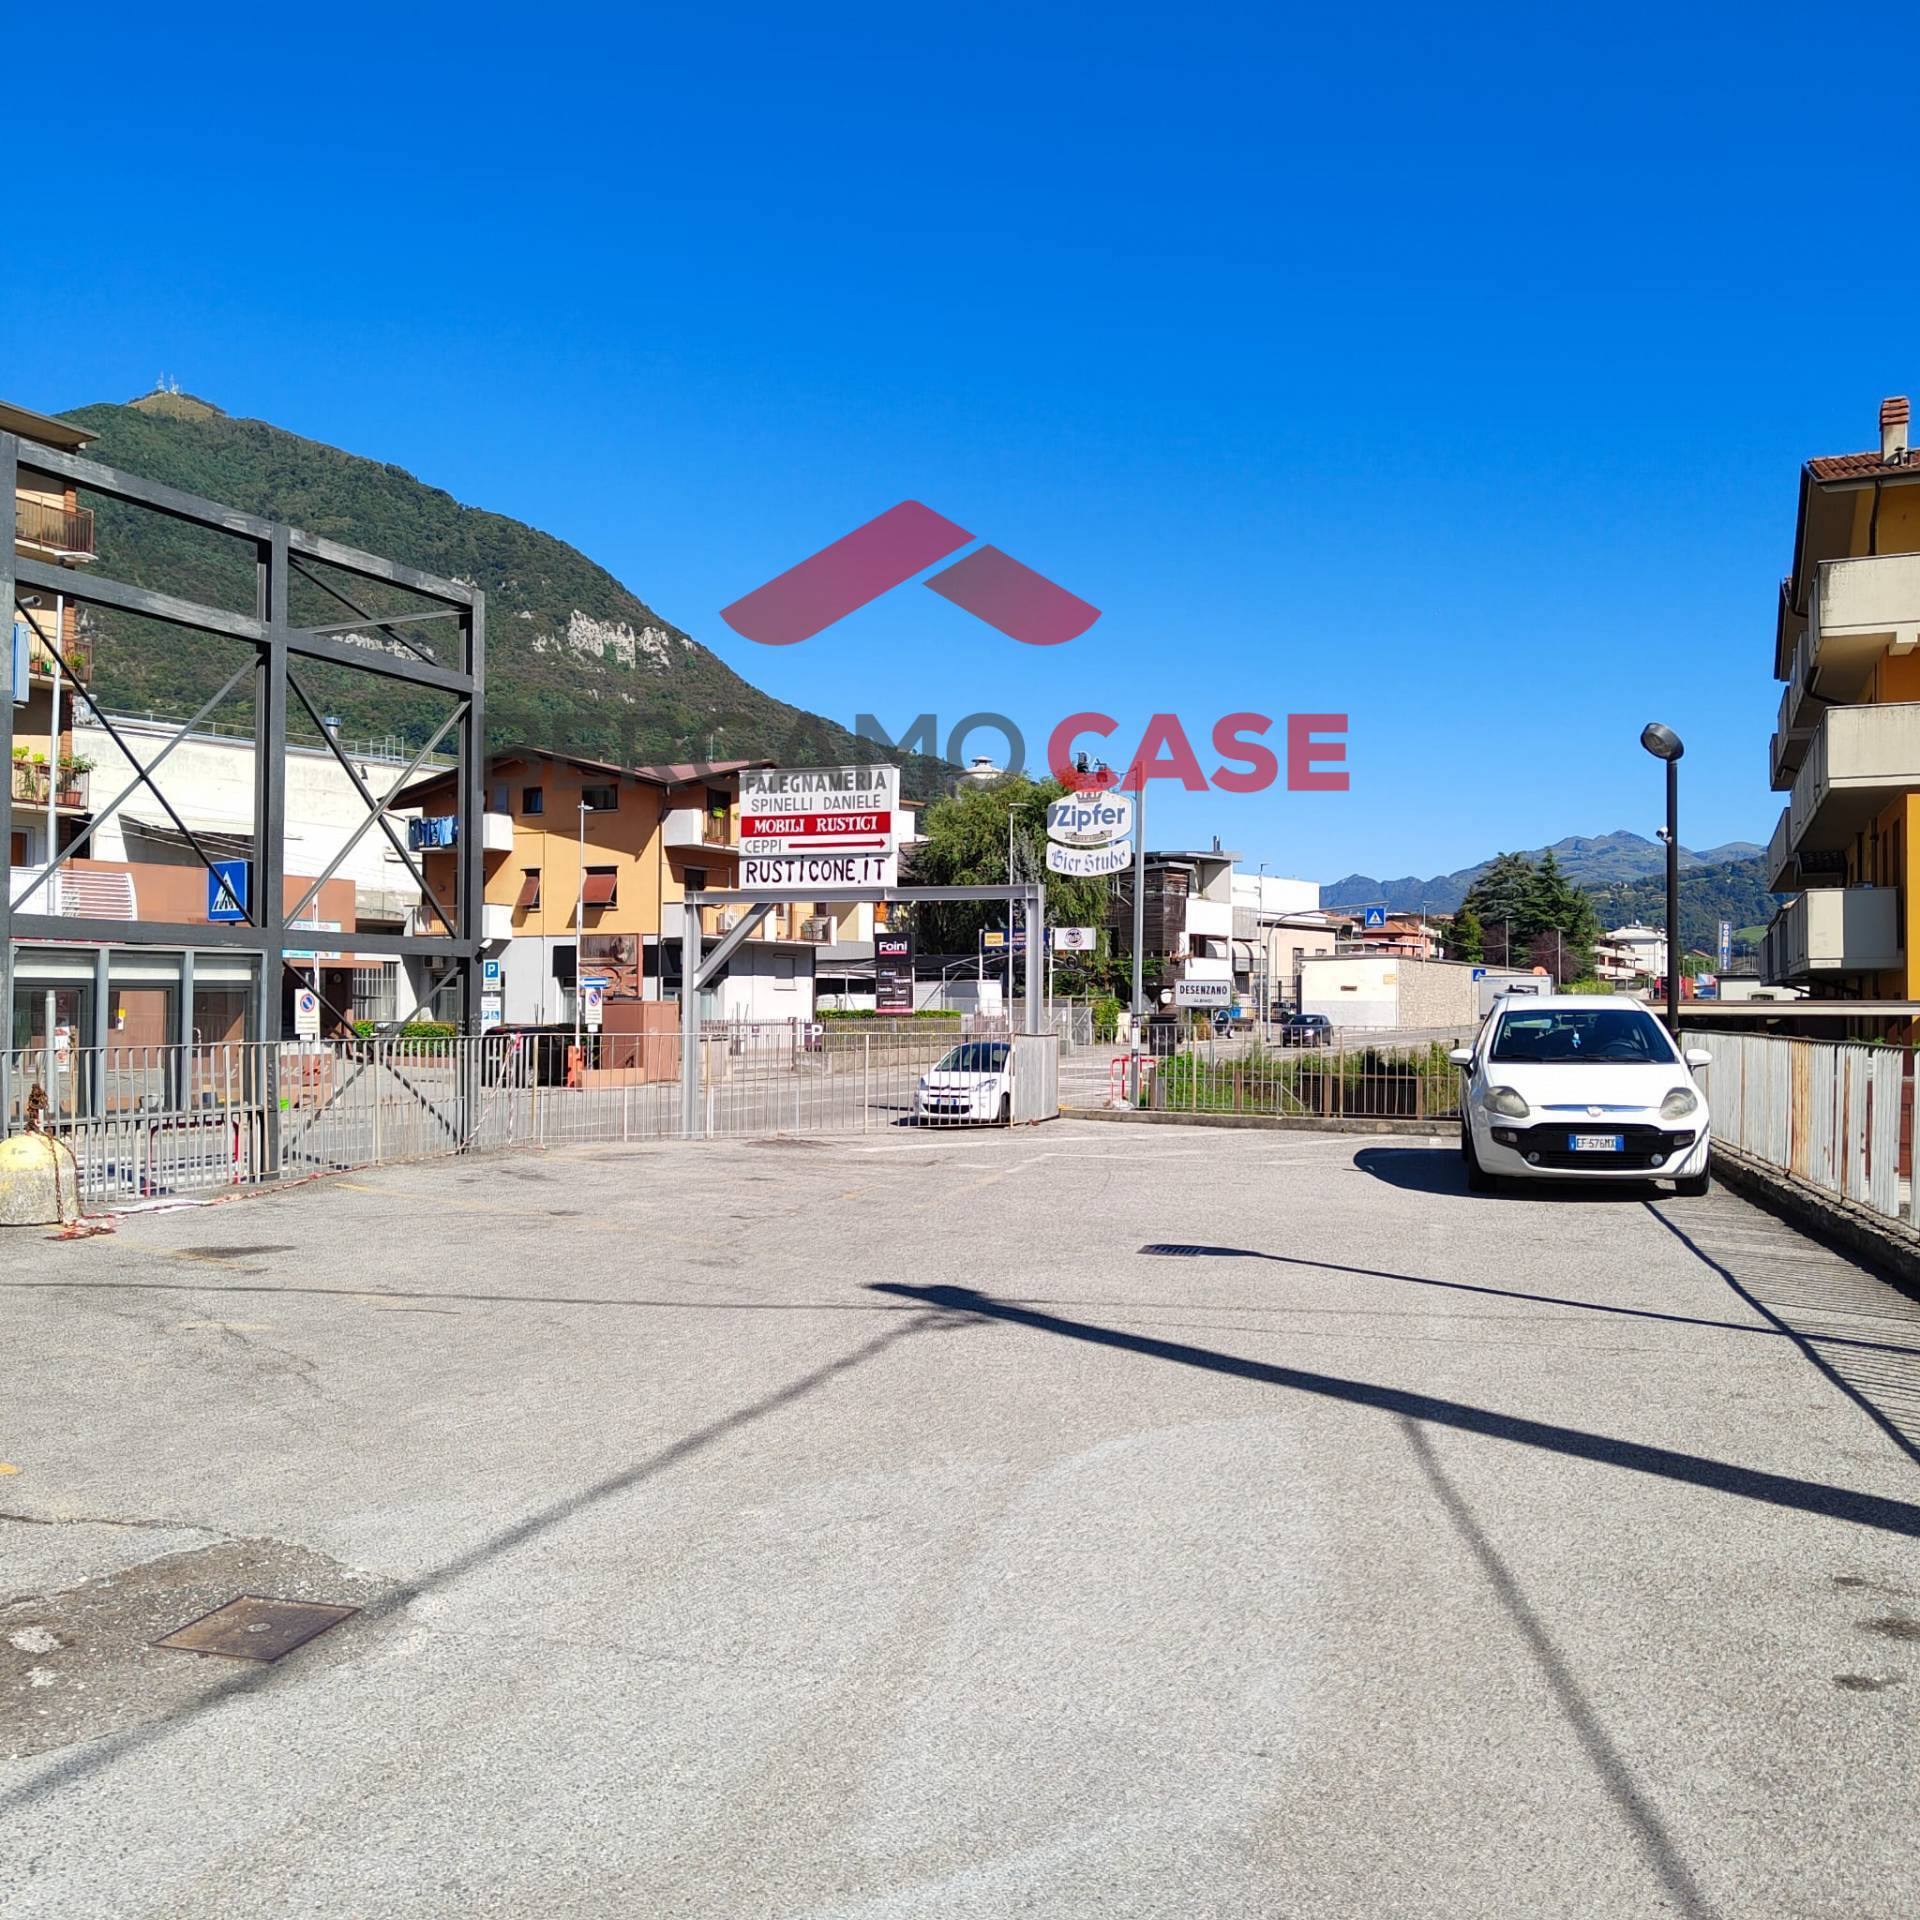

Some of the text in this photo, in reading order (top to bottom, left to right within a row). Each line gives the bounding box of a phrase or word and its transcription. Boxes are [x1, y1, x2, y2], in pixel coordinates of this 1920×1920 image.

[745, 770, 886, 794] FALEGNAMERIA
[751, 794, 881, 812] SPINELLI DANIELE
[753, 815, 877, 834] MOBILI RUSTICI
[1056, 803, 1126, 832] Zipfer
[745, 839, 782, 854] CEPPI
[1051, 849, 1081, 872] Bier
[746, 858, 886, 884] RUSTICONE.IT
[879, 940, 908, 951] Foini
[1179, 984, 1228, 995] DESENZANO
